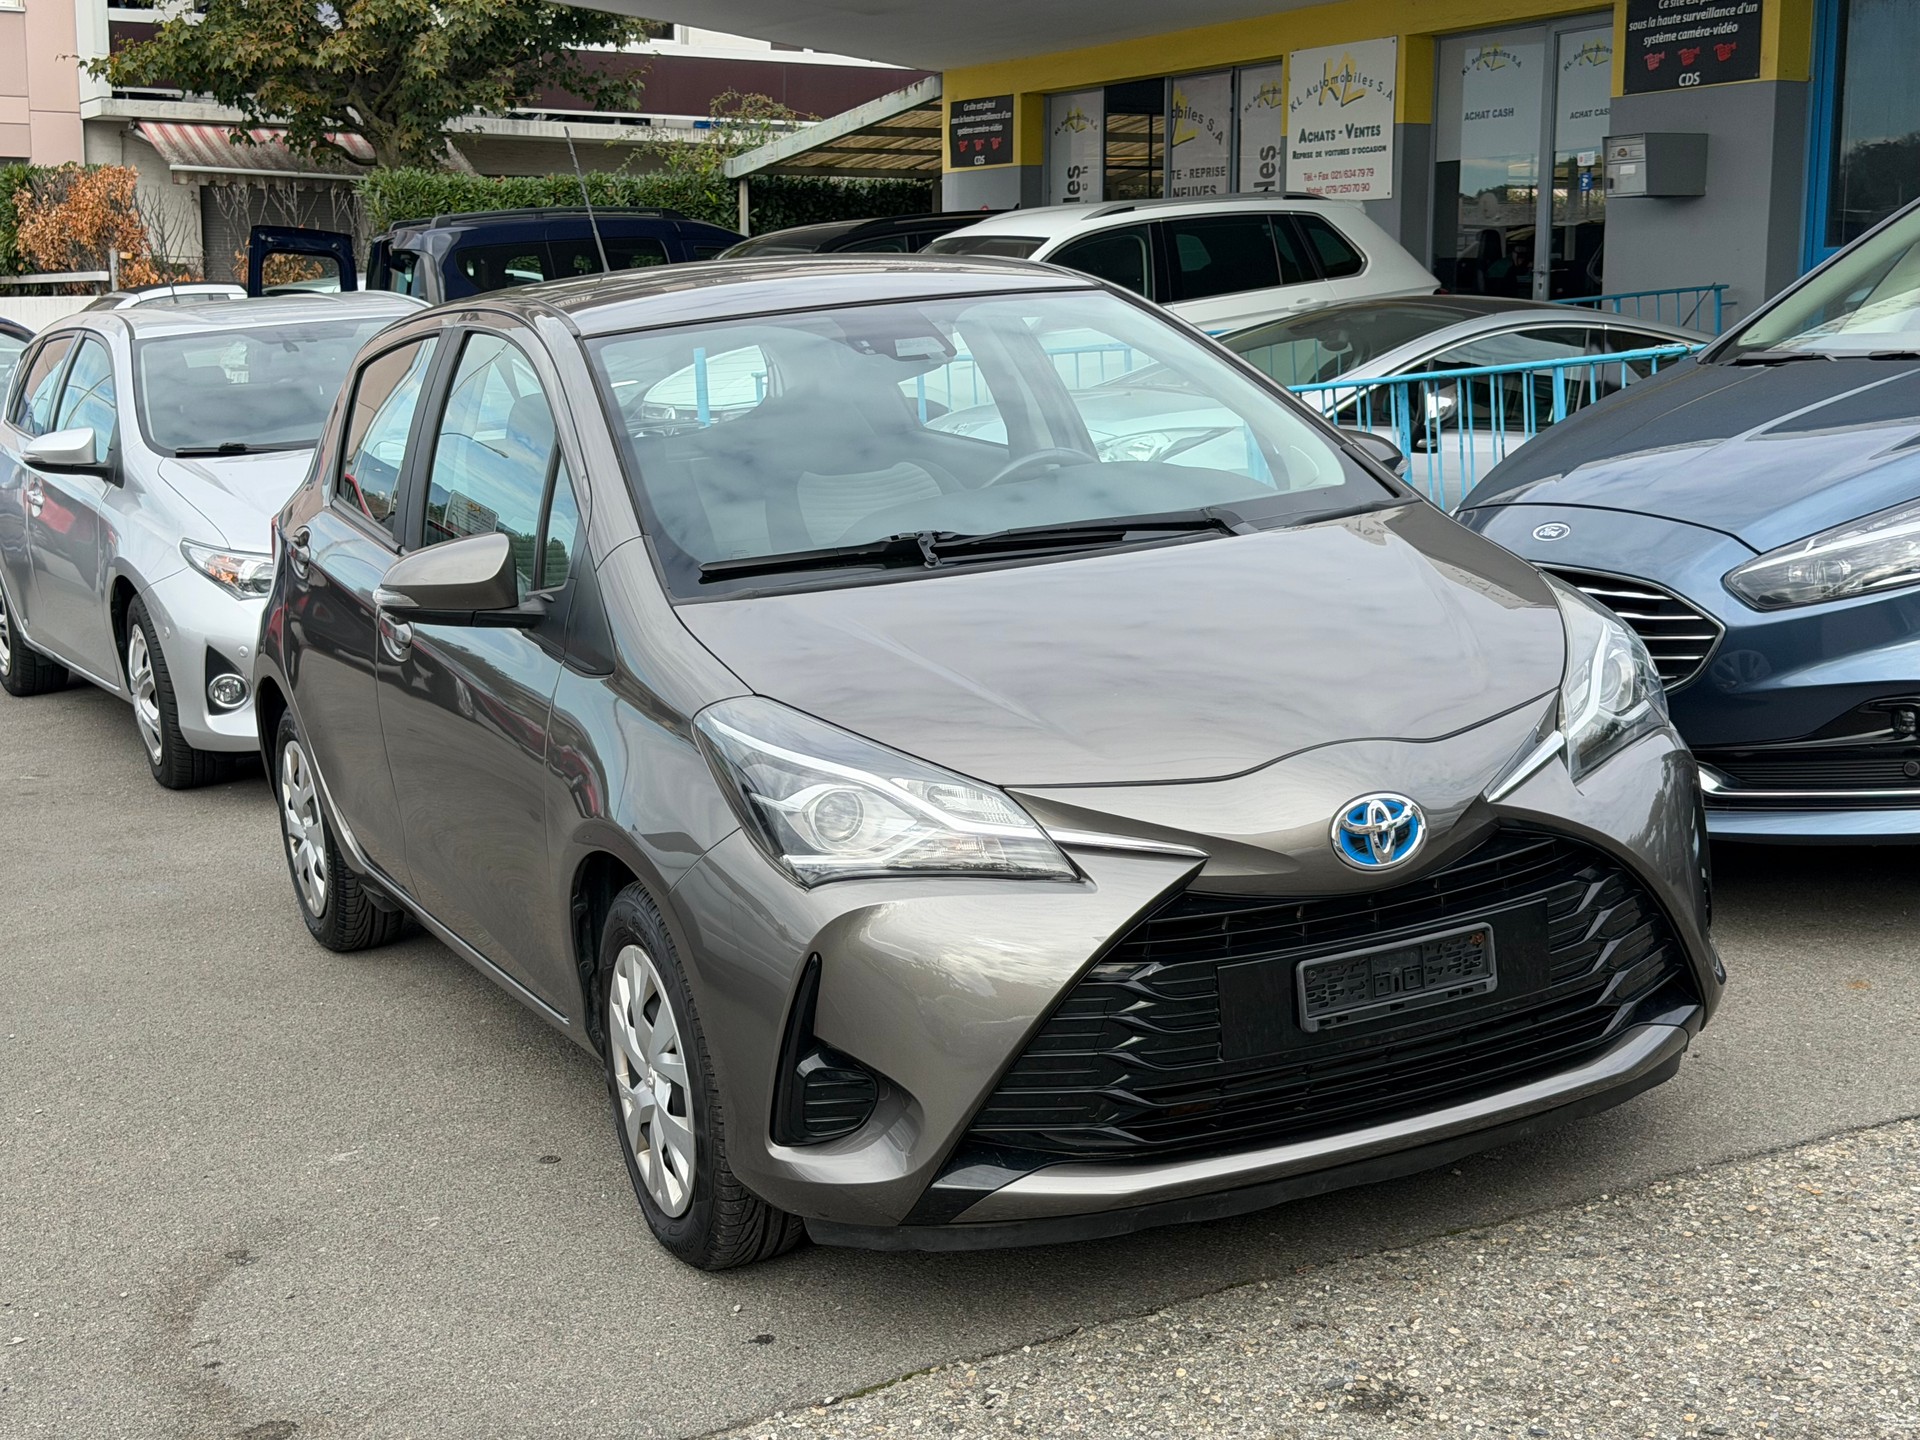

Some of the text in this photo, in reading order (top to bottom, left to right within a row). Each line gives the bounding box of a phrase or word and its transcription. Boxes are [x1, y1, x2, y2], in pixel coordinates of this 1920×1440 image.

[1629, 2, 1758, 31] sous la haute surveillance d'un
[1643, 21, 1738, 48] système caméra-vidéo
[1679, 72, 1700, 86] CDS
[1290, 96, 1304, 112] KL
[1306, 72, 1373, 99] Automobiles
[1464, 107, 1514, 121] ACHAT CASH
[1570, 108, 1610, 119] ACHAT CAS
[1298, 128, 1336, 144] ACHATS
[1345, 123, 1381, 139] VENTES
[1189, 166, 1226, 178] REPRISE
